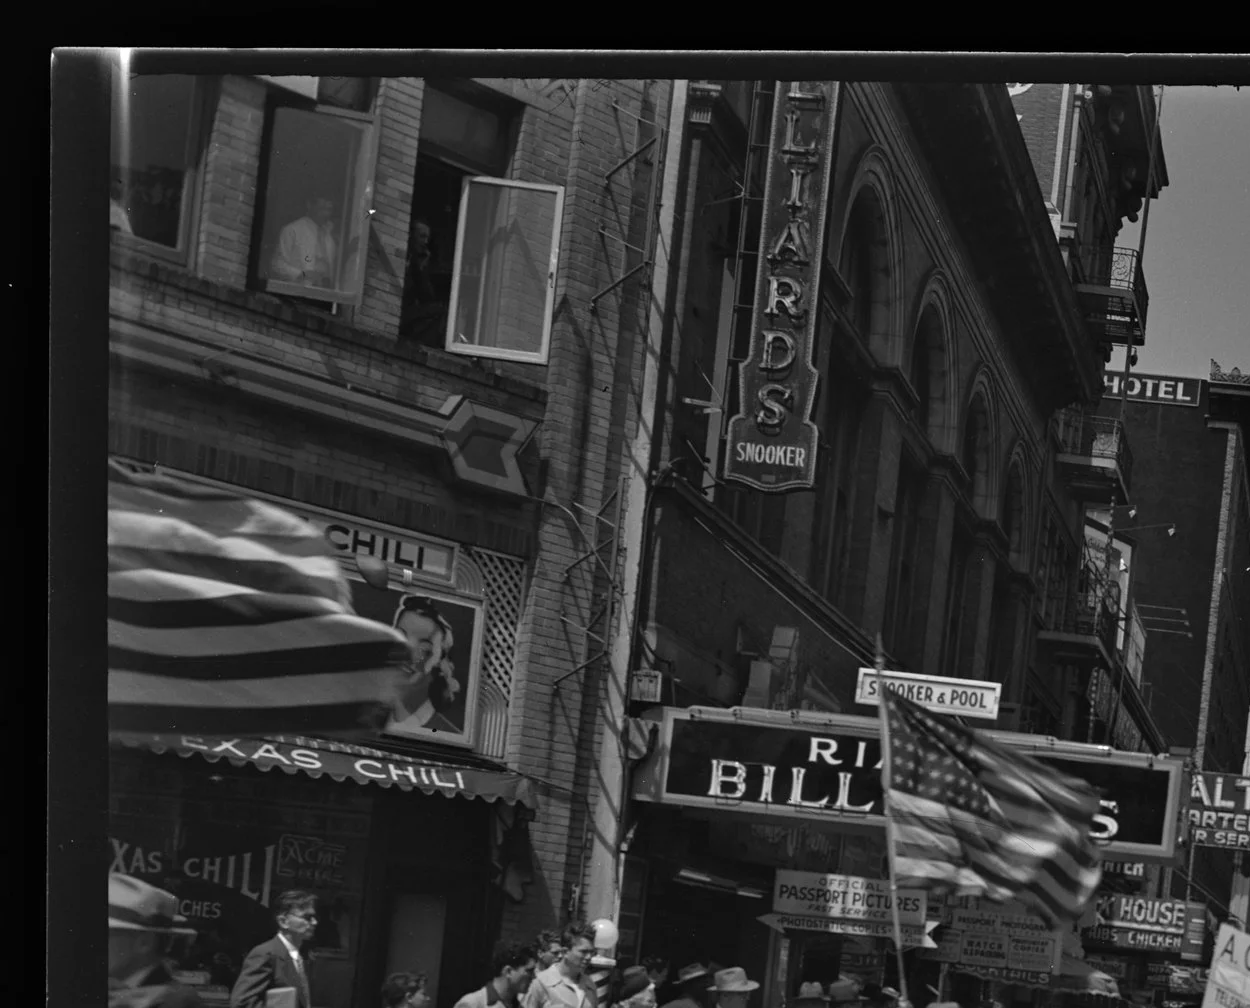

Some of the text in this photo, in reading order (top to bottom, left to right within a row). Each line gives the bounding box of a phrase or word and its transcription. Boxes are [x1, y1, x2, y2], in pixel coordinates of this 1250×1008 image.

[1103, 374, 1192, 402] HOTEL
[736, 441, 806, 469] SNOOKER
[325, 524, 424, 570] CHILI
[868, 680, 933, 702] SOOKER
[950, 689, 987, 709] POOL
[181, 736, 322, 770] EXAS
[355, 758, 465, 790] CHILI
[1192, 830, 1207, 844] R
[184, 845, 277, 909] CHILI
[818, 877, 885, 893] OFFICIAL
[778, 884, 848, 905] PASSPORT
[177, 899, 222, 919] CHES
[807, 904, 888, 919] FAST SERVICE
[1119, 897, 1186, 926] HOUSE
[781, 916, 888, 935] PHOTOSTATIC COPIES
[1128, 930, 1182, 948] CHICKEN
